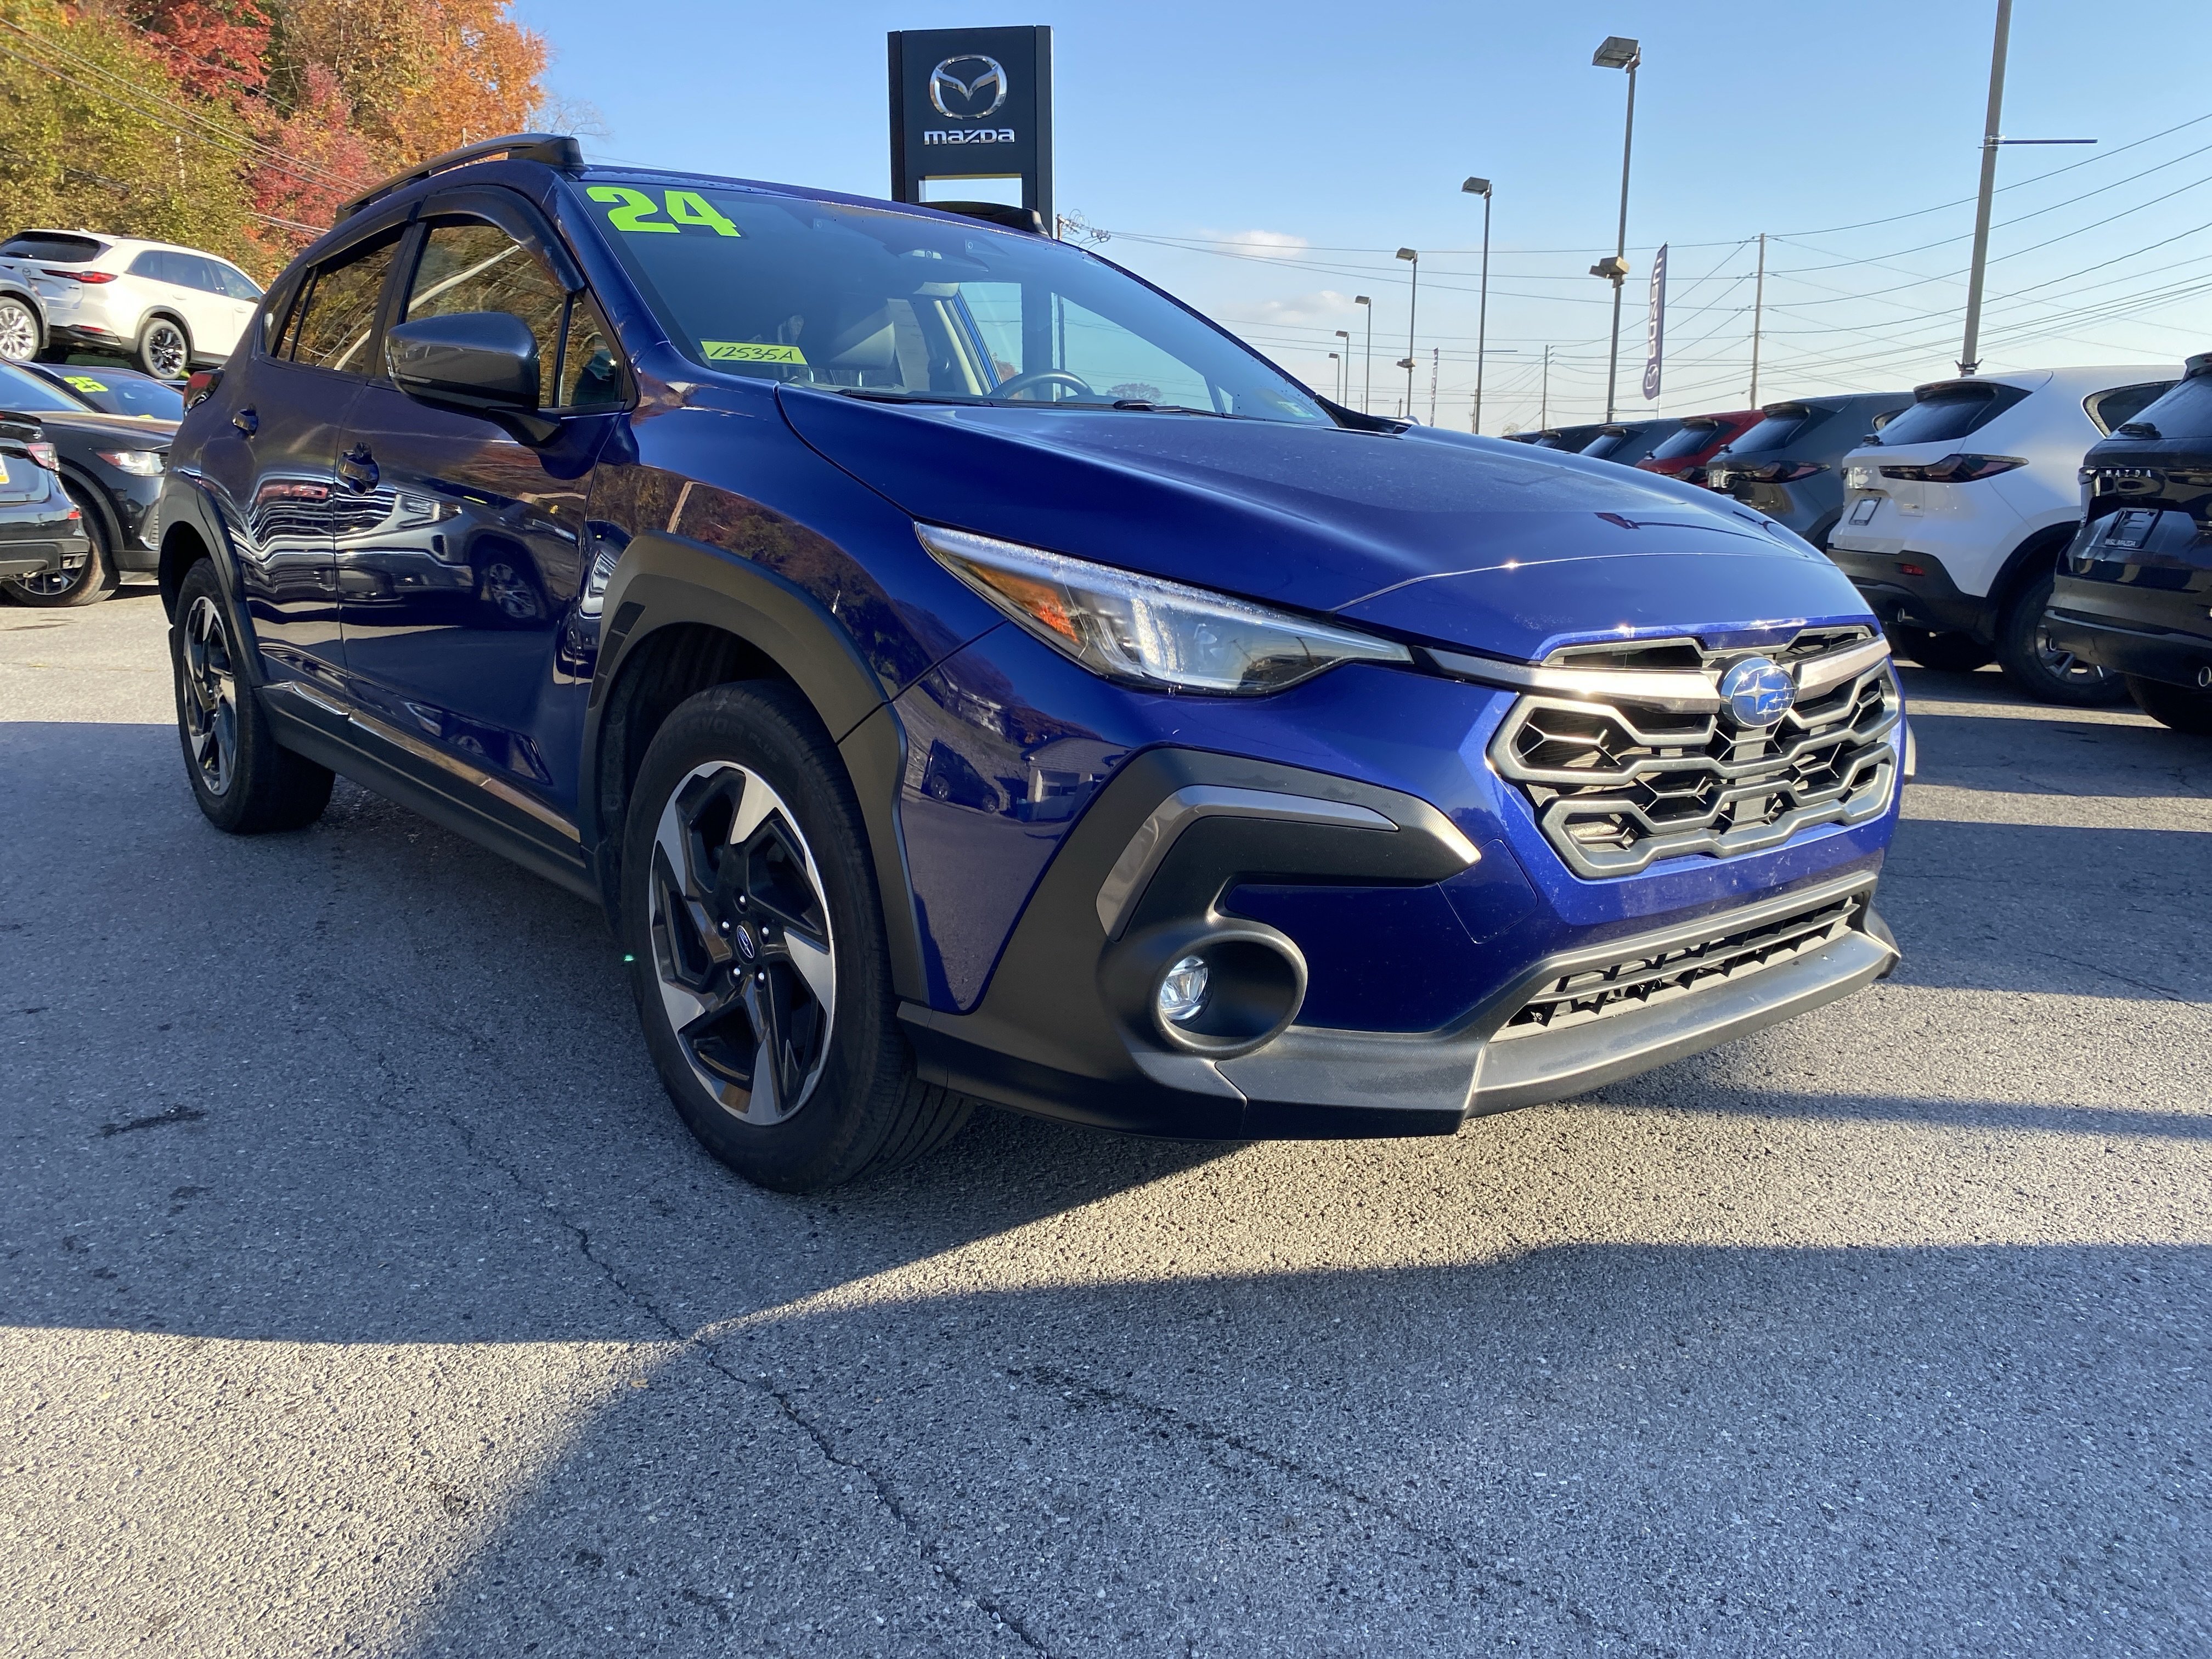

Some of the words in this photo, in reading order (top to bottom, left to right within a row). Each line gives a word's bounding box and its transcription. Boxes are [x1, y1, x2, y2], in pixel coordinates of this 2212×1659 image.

[586, 186, 741, 237] 24
[710, 346, 793, 362] 12535A
[63, 376, 109, 393] 25
[2106, 469, 2152, 478] MAZDA
[749, 732, 780, 763] PLUS
